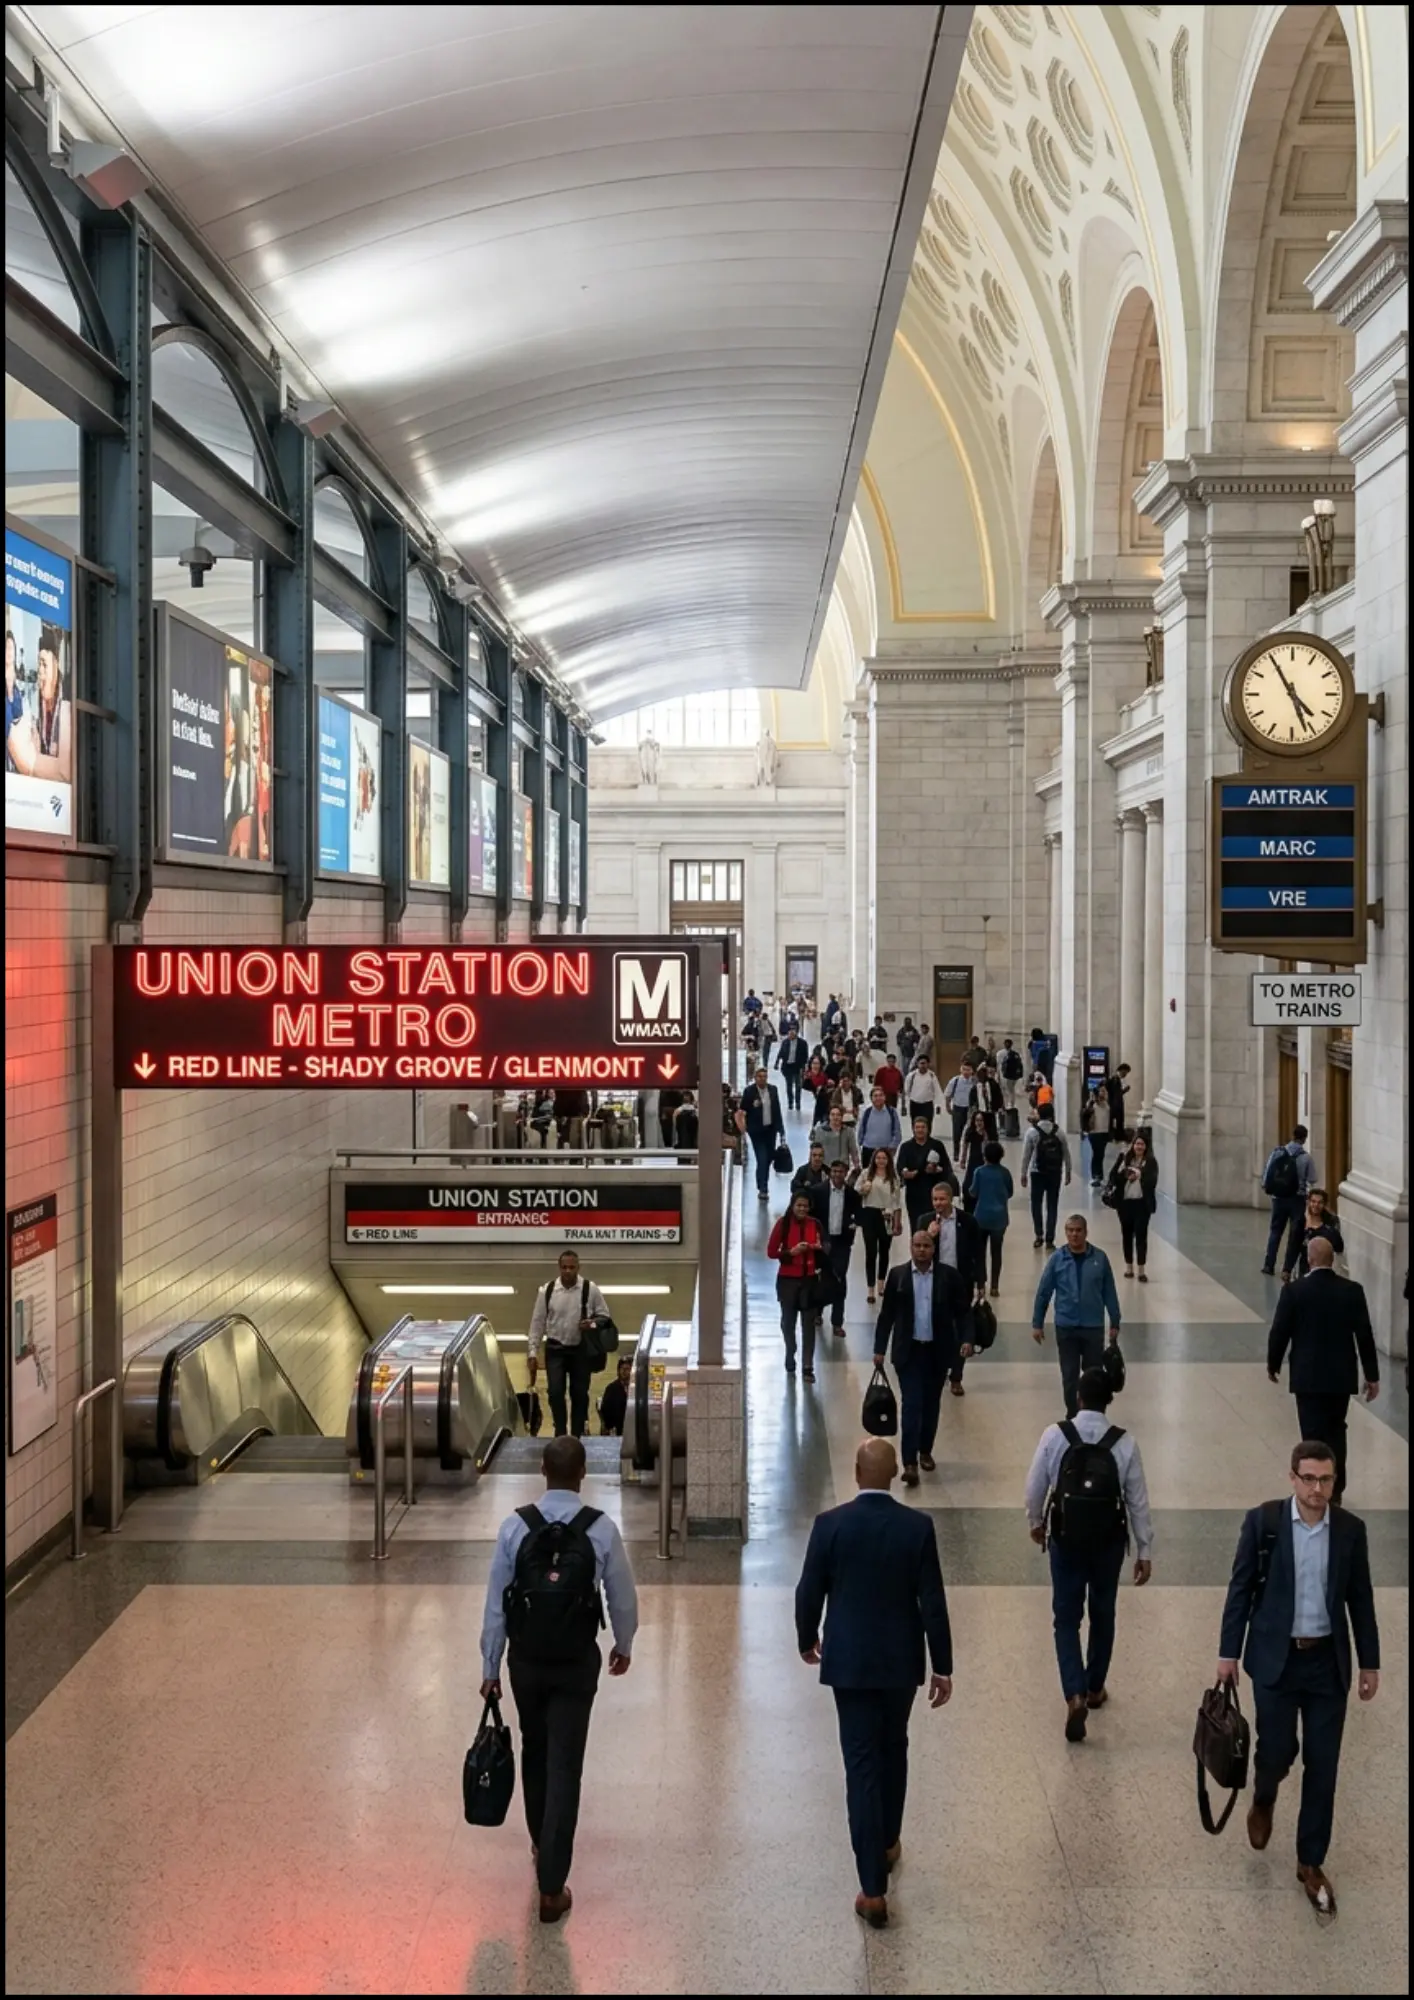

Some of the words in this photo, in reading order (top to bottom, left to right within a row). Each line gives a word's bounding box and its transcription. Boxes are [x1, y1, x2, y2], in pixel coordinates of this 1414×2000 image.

[1248, 789, 1328, 805] AMTRAK
[1260, 840, 1316, 856] MARC
[1269, 891, 1306, 906] VRE
[135, 951, 320, 998] UNION
[348, 950, 590, 998] STATION
[619, 959, 682, 1020] M
[1259, 983, 1285, 998] TO
[1290, 982, 1356, 999] METRO
[1275, 1002, 1342, 1018] TRAINS
[271, 1002, 478, 1048] METRO
[619, 1022, 682, 1037] WMATA
[169, 1056, 218, 1077] RED
[227, 1056, 282, 1077] LINE
[304, 1056, 389, 1078] SHADY
[395, 1056, 482, 1078] GROVE
[505, 1056, 645, 1078] GLENMONT
[428, 1189, 499, 1207] UNION
[508, 1189, 598, 1208] STATION
